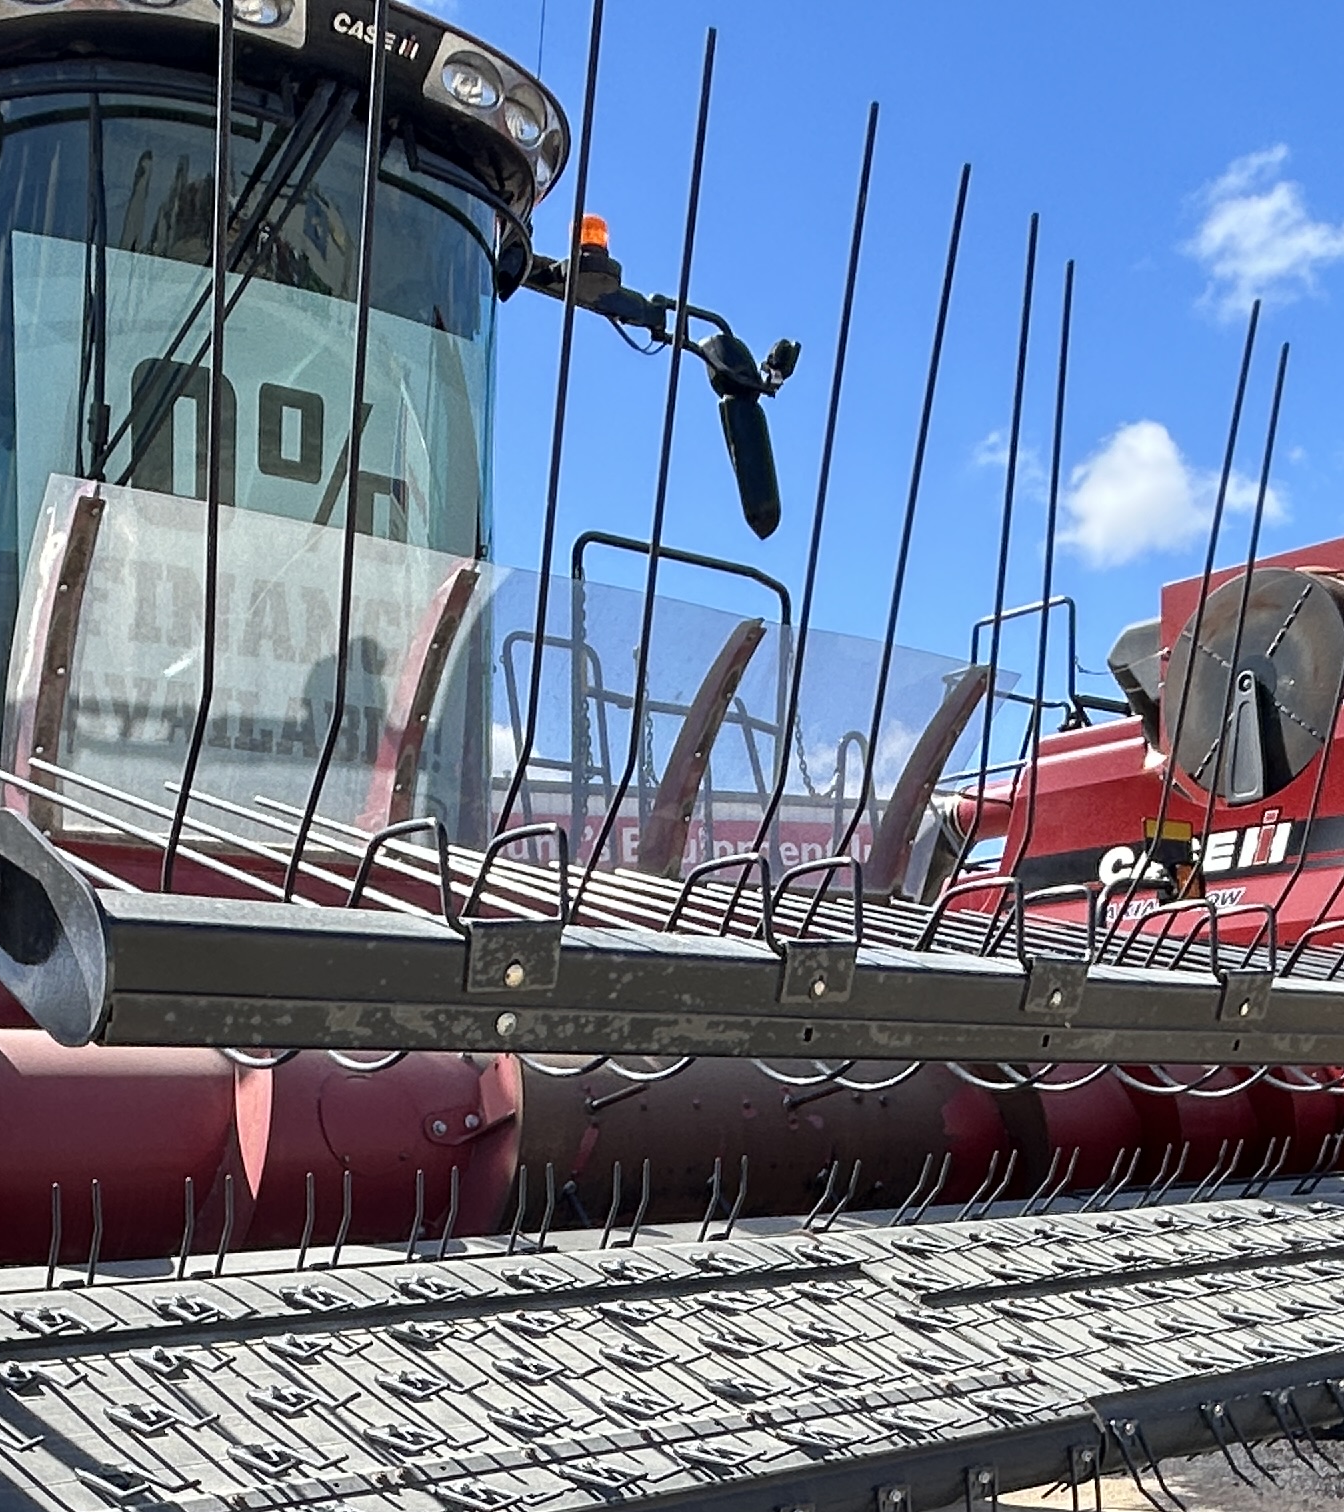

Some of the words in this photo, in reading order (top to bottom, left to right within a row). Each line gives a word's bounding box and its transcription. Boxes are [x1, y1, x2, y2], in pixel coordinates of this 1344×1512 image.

[333, 12, 396, 51] CASE
[130, 357, 409, 562] 0%
[88, 558, 414, 680] FINANC
[622, 826, 846, 874] Euipment
[1098, 829, 1240, 887] CAE
